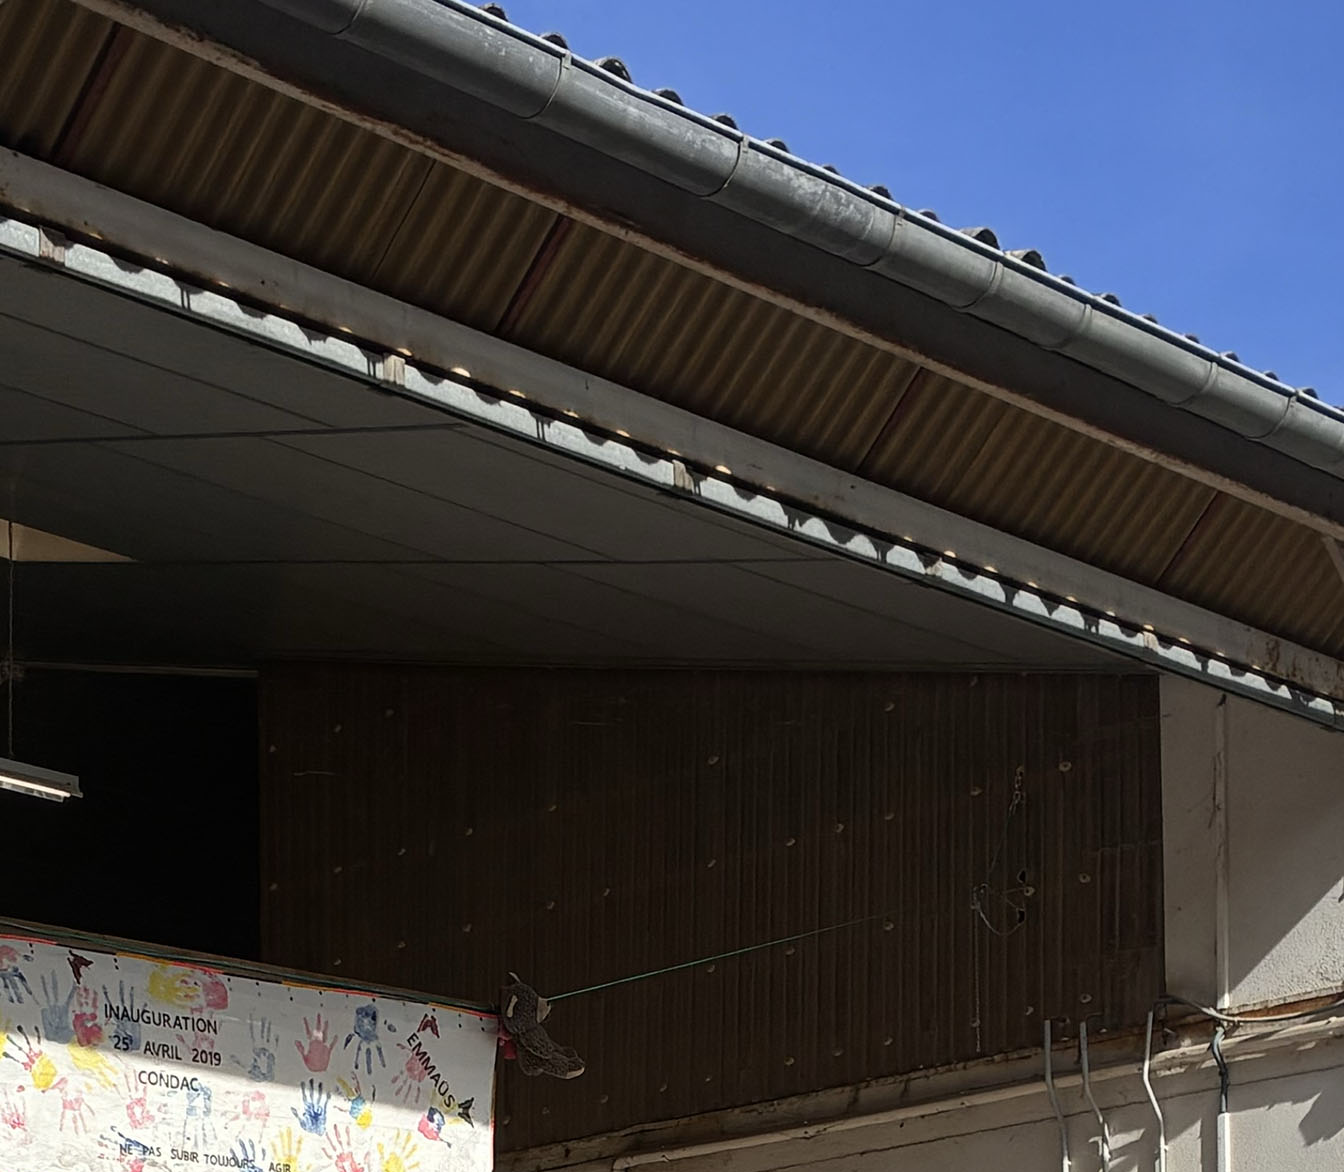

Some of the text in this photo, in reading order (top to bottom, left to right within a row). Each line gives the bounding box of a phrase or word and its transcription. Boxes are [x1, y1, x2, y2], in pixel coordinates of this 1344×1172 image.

[103, 1003, 219, 1036] INAUGURATION
[143, 1040, 183, 1061] AVRIL
[191, 1048, 222, 1067] 2019
[137, 1070, 200, 1092] CONDAC
[119, 1143, 133, 1157] NE
[142, 1145, 162, 1158] PAS
[170, 1148, 200, 1164] SUBIR
[203, 1153, 256, 1170] TOUJOURS
